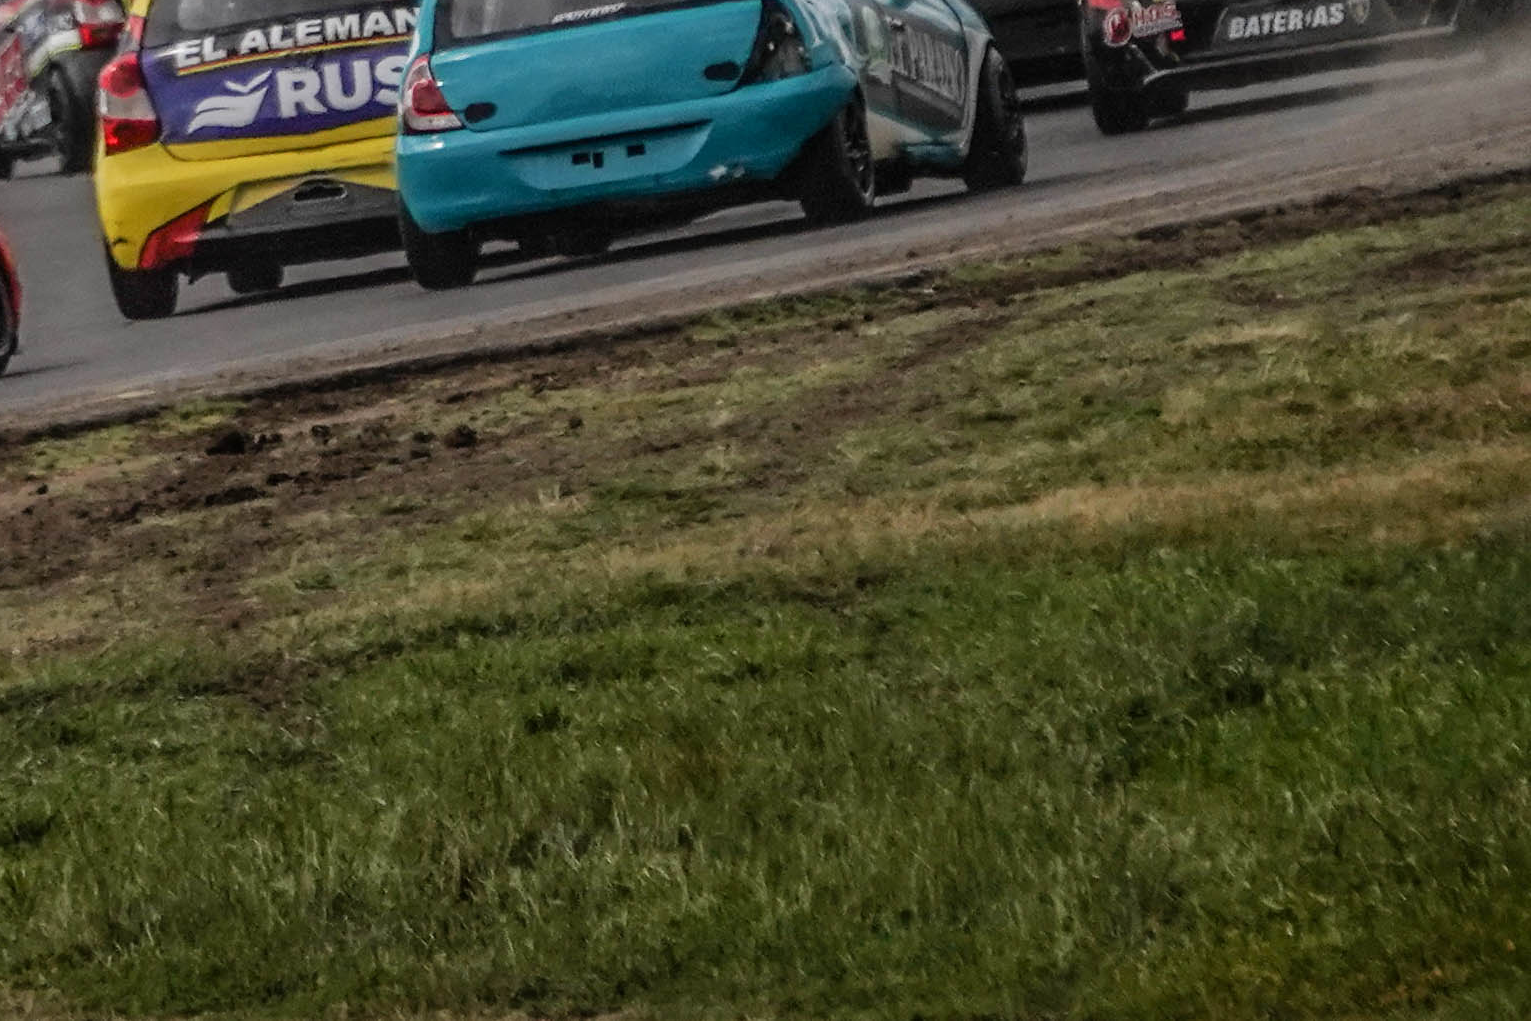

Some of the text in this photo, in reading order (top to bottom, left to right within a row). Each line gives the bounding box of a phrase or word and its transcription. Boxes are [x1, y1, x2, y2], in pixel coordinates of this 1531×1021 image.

[176, 7, 420, 70] EL ALEMAN
[277, 53, 410, 119] RUS
